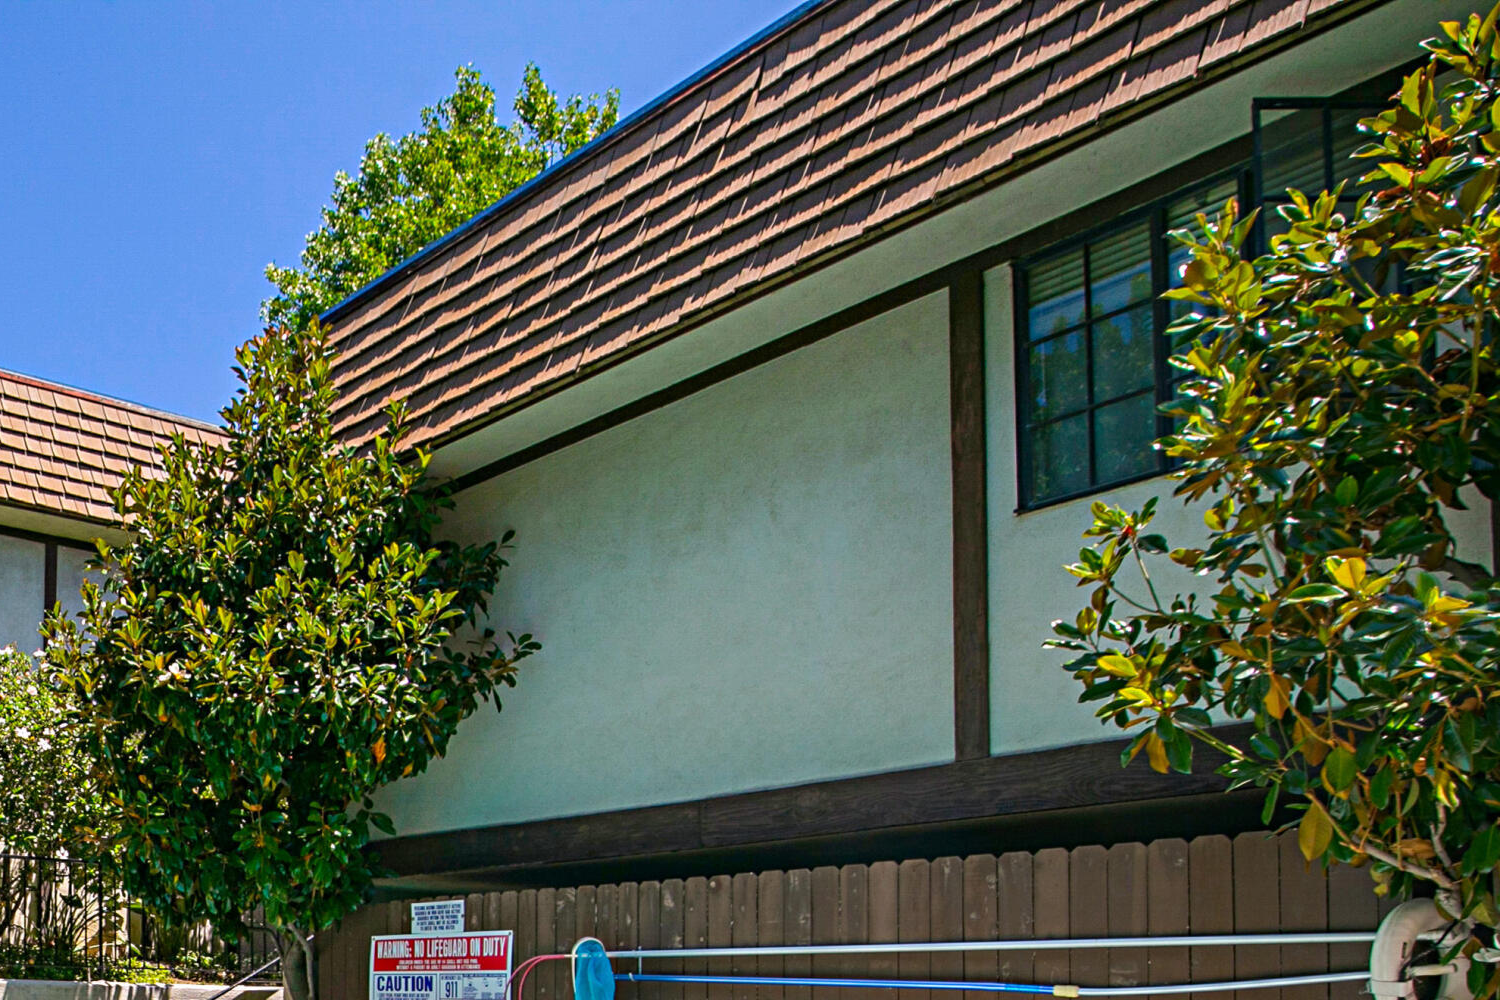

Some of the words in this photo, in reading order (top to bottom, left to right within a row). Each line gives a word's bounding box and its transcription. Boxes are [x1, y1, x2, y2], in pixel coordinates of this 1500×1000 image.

[377, 940, 412, 959] WARNING:
[414, 939, 425, 958] NO
[426, 938, 468, 958] LIFEGUARD
[470, 938, 480, 957] ON
[483, 937, 506, 957] DUTY
[377, 976, 433, 992] CAUTION
[445, 981, 458, 998] 911
